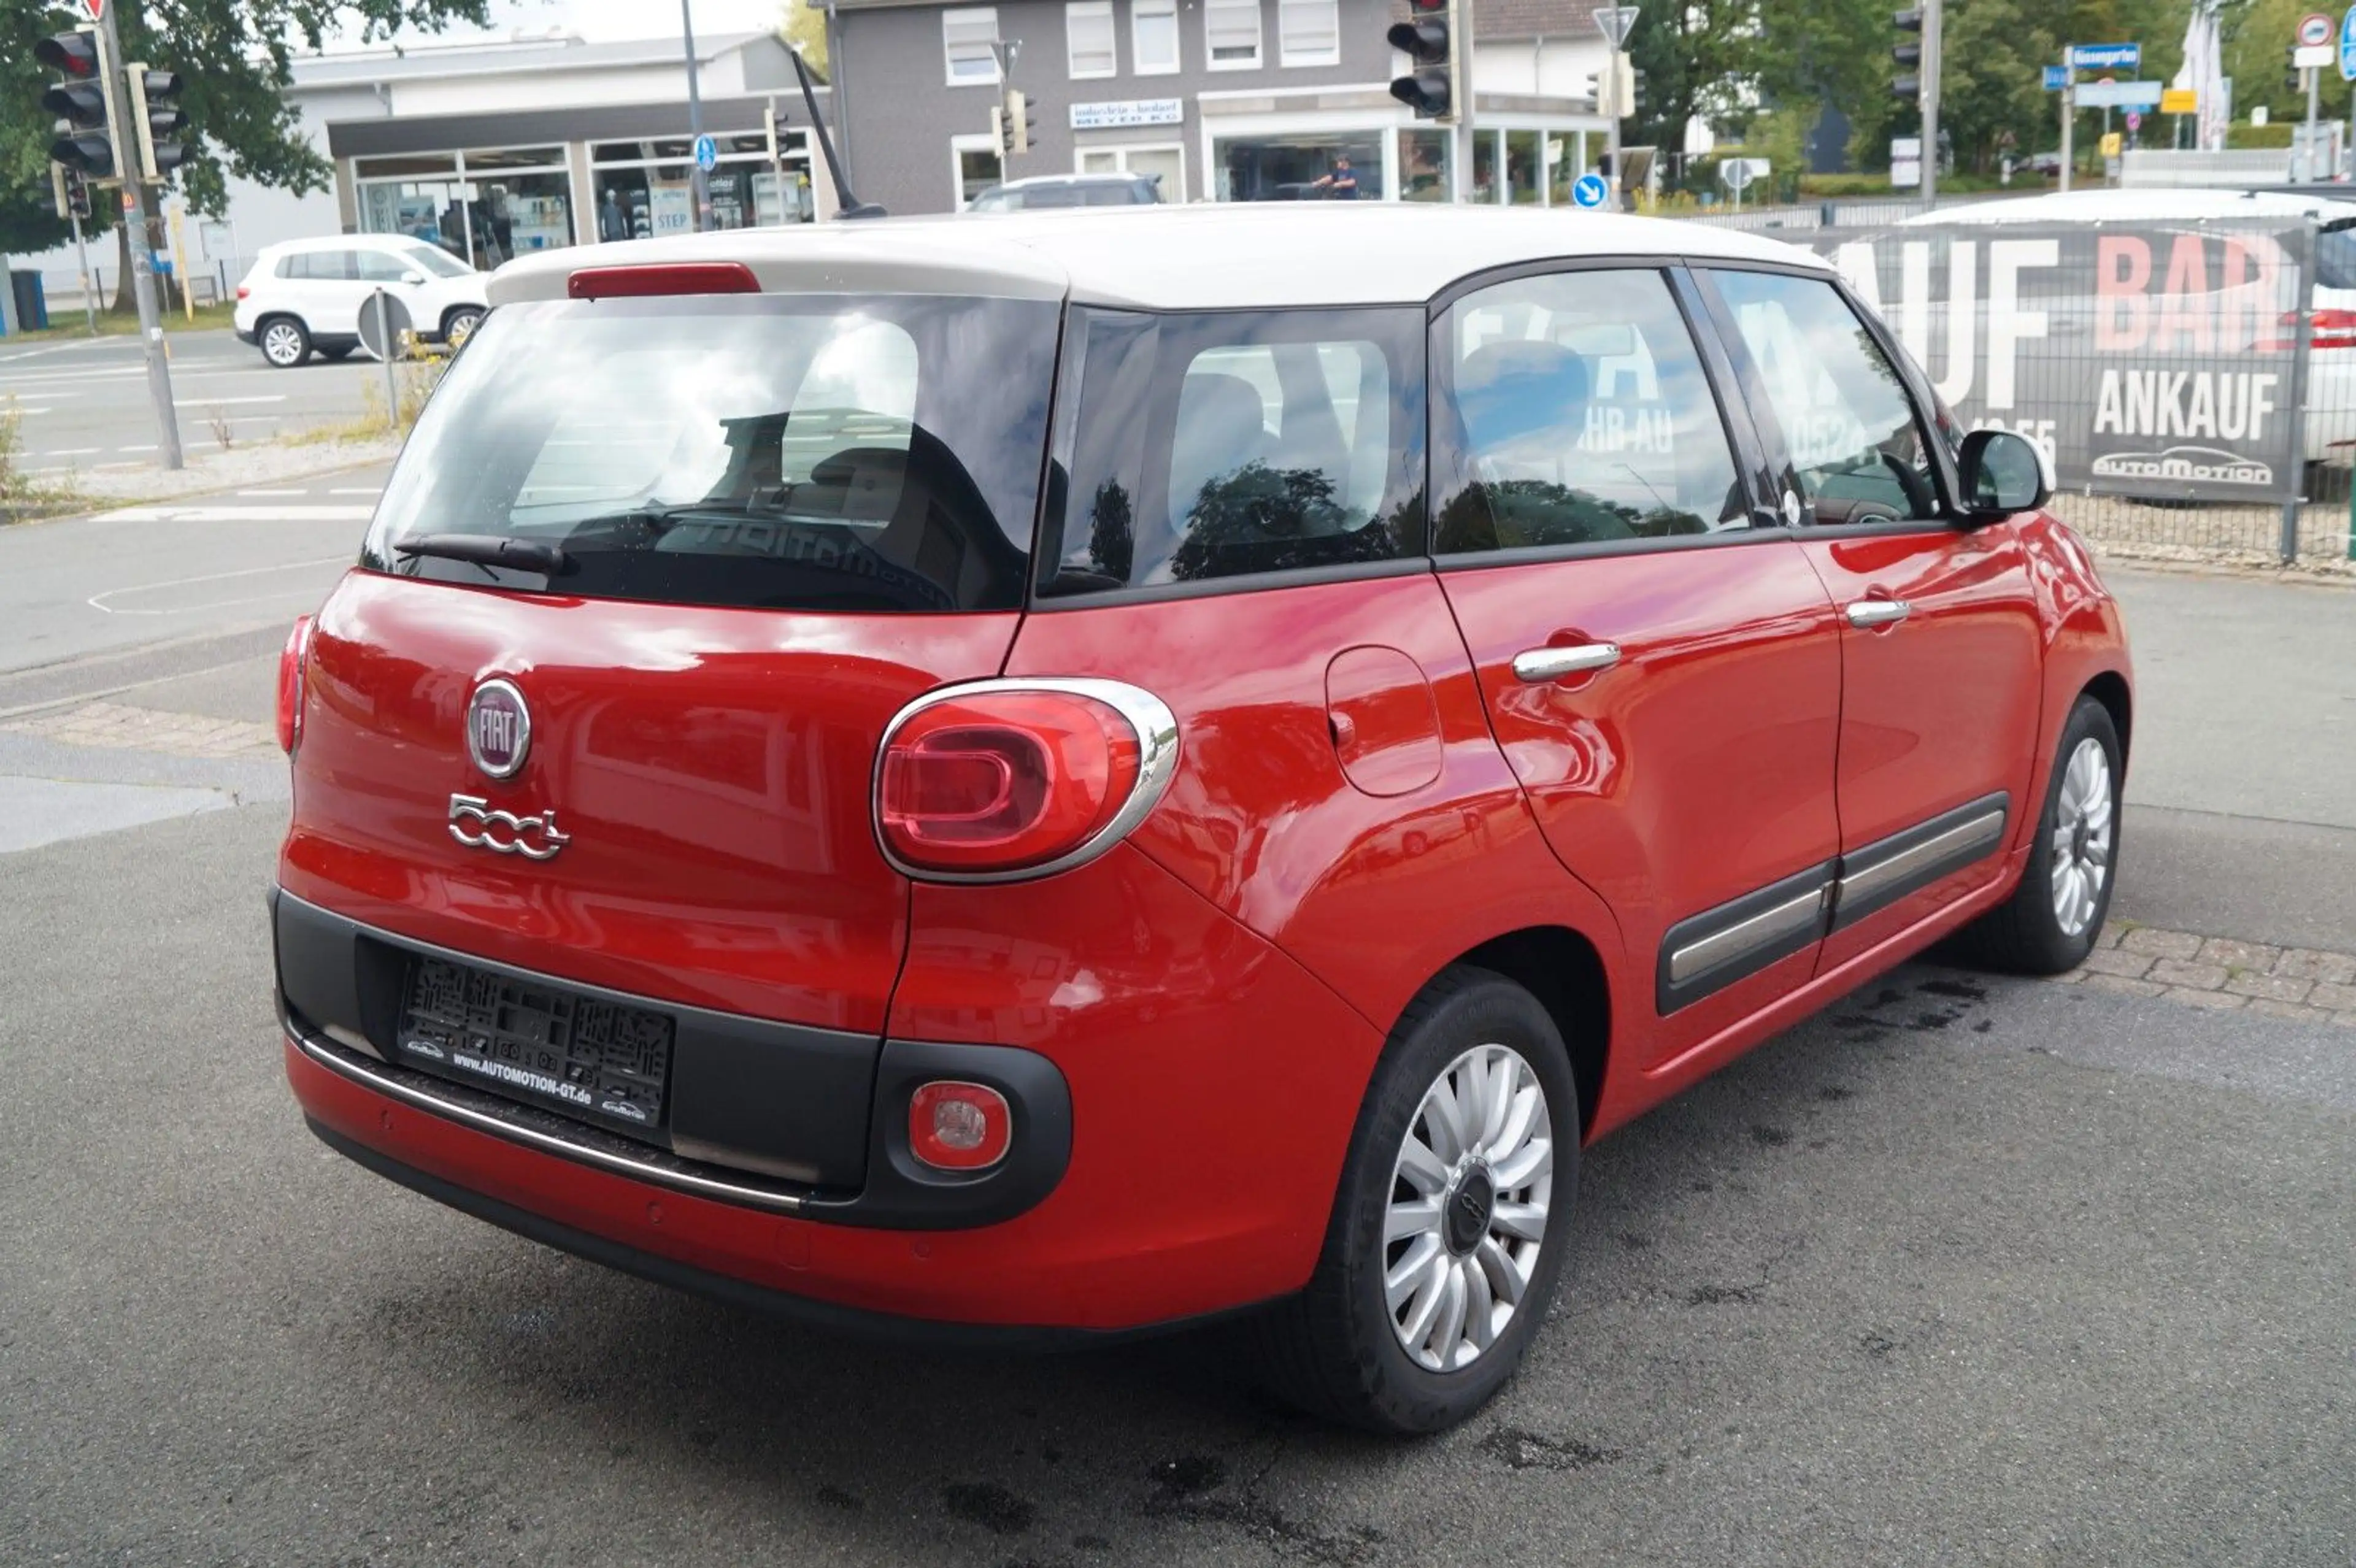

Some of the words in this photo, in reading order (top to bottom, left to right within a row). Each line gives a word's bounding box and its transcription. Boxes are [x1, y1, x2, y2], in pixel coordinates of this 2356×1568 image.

[658, 213, 687, 229] STEP
[2095, 235, 2279, 354] BAR
[2093, 369, 2278, 440] ANKAUF
[480, 707, 514, 753] FIAT
[453, 1052, 592, 1105] www.AUTOMOTION-GT.de
